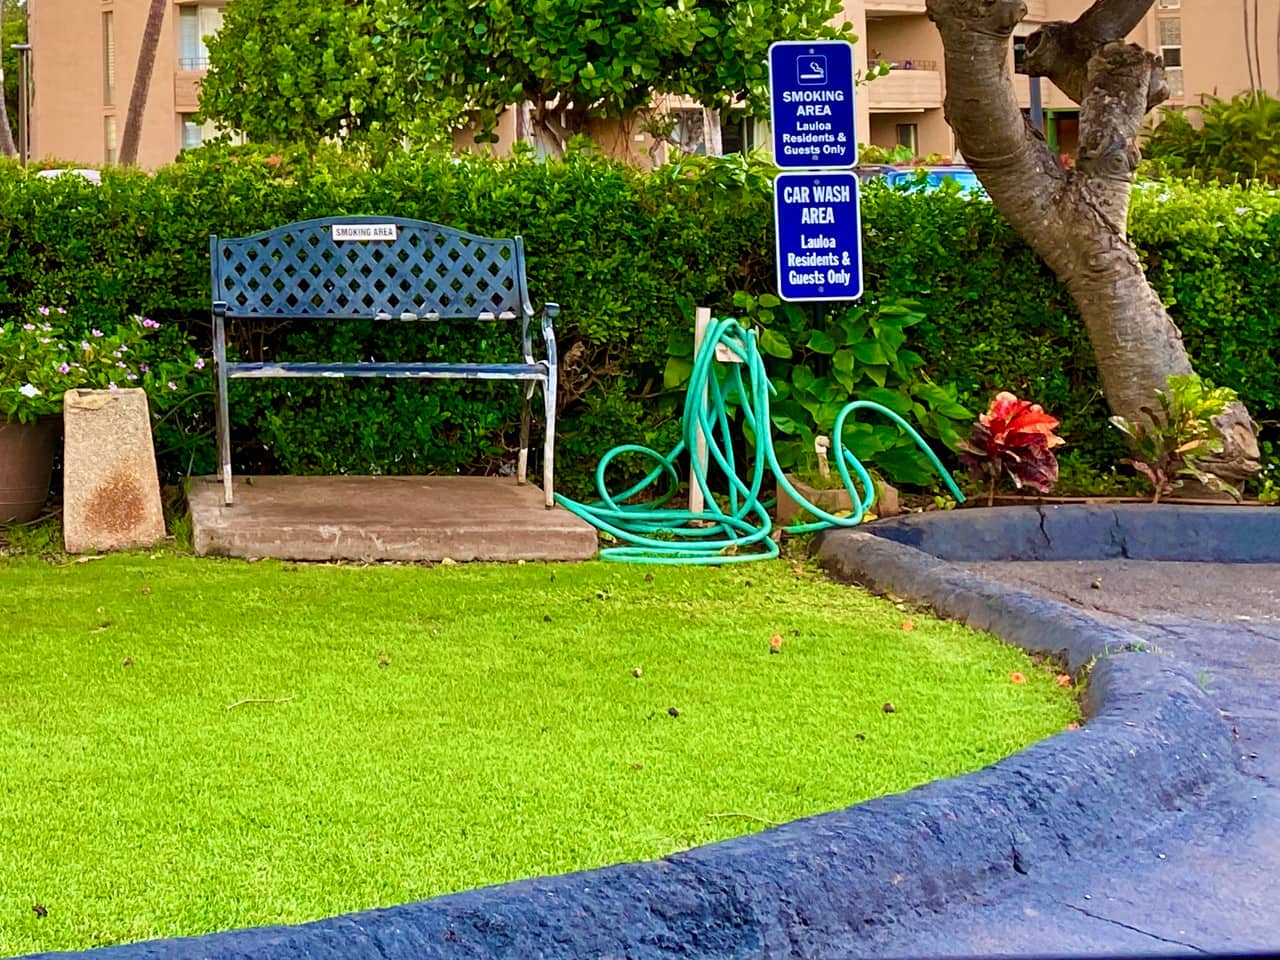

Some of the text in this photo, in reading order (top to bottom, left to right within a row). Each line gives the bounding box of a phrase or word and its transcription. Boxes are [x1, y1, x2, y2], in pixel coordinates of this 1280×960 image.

[782, 90, 844, 102] SMOKING
[796, 105, 832, 116] AREA
[796, 121, 832, 131] Lauloa
[782, 132, 847, 143] Residents &
[784, 144, 846, 156] Guests Only
[783, 185, 850, 203] CAR WASH
[801, 207, 835, 224] AREA
[335, 228, 393, 236] SMOKING AREA
[800, 234, 836, 249] Lauloa
[787, 251, 851, 267] Residents &
[788, 269, 851, 286] Guests Only
